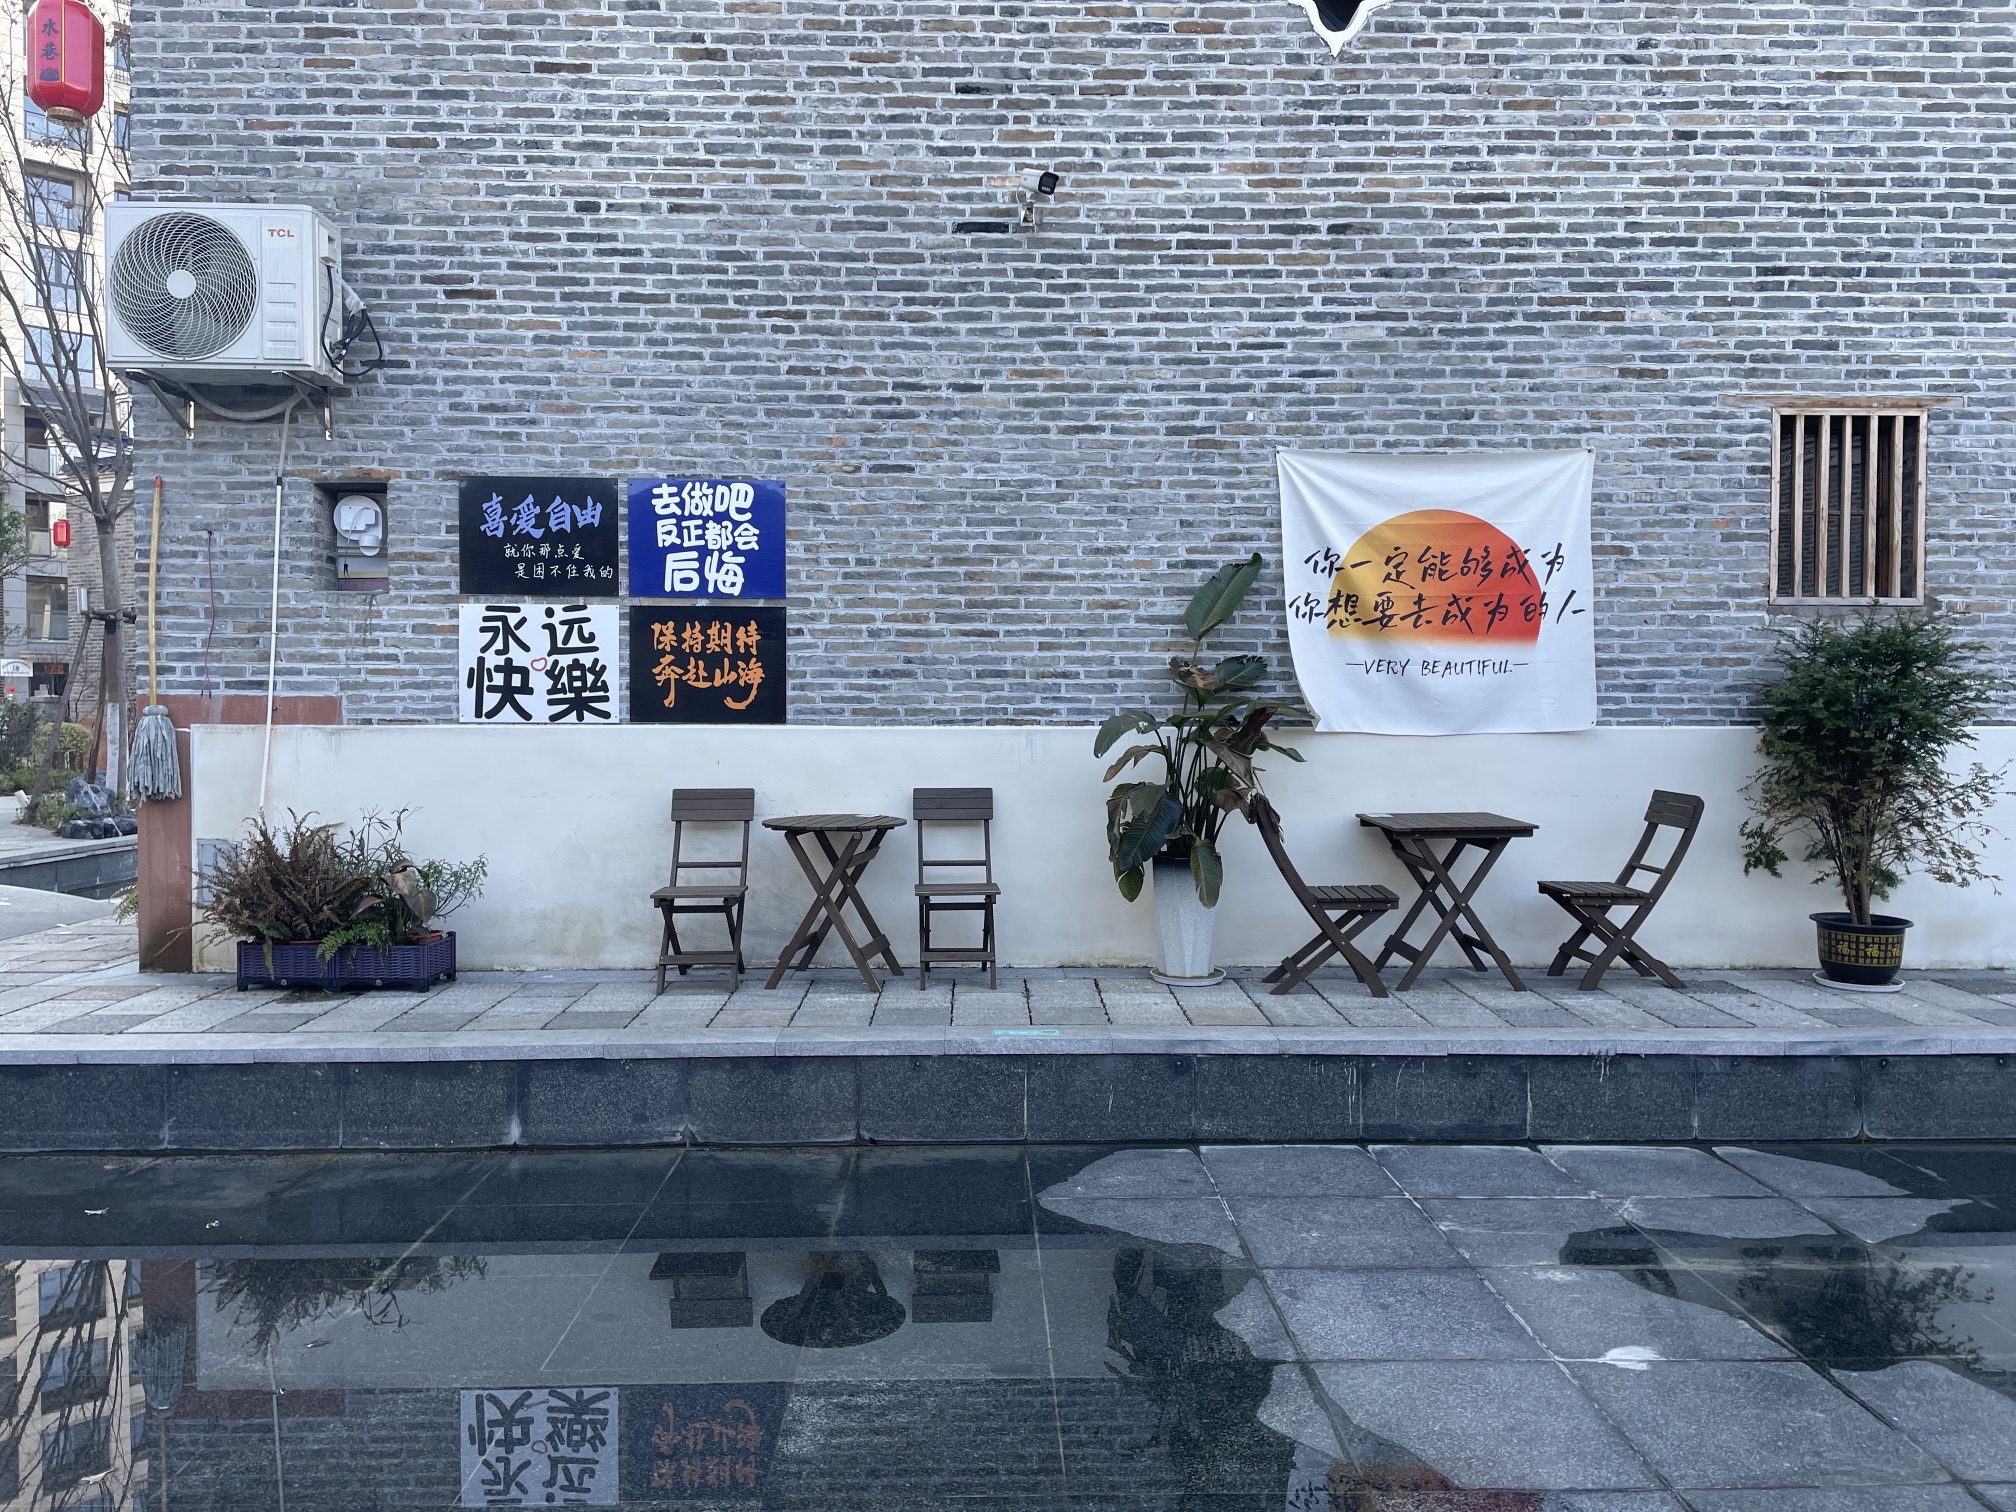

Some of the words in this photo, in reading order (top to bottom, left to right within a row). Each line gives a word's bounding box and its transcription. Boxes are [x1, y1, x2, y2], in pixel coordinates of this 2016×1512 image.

[40, 18, 60, 61] 水巷
[267, 228, 295, 238] TCL
[480, 492, 603, 539] 喜爱自由
[651, 481, 755, 522] 去做吧
[503, 543, 586, 560] 就你那点爱
[656, 518, 760, 551] 反正都会
[514, 563, 614, 579] 是困不住我的
[664, 551, 746, 597] 后悔
[1304, 542, 1566, 590] 你一定能够成为
[478, 604, 600, 657] 永远
[1288, 589, 1587, 635] 你想要去成为的人
[651, 620, 763, 656] 保持期待
[466, 656, 612, 723] 快樂
[651, 654, 766, 710] 奔赴山海
[1364, 658, 1410, 676] VERY
[1421, 658, 1513, 678] BEAUTIFUL
